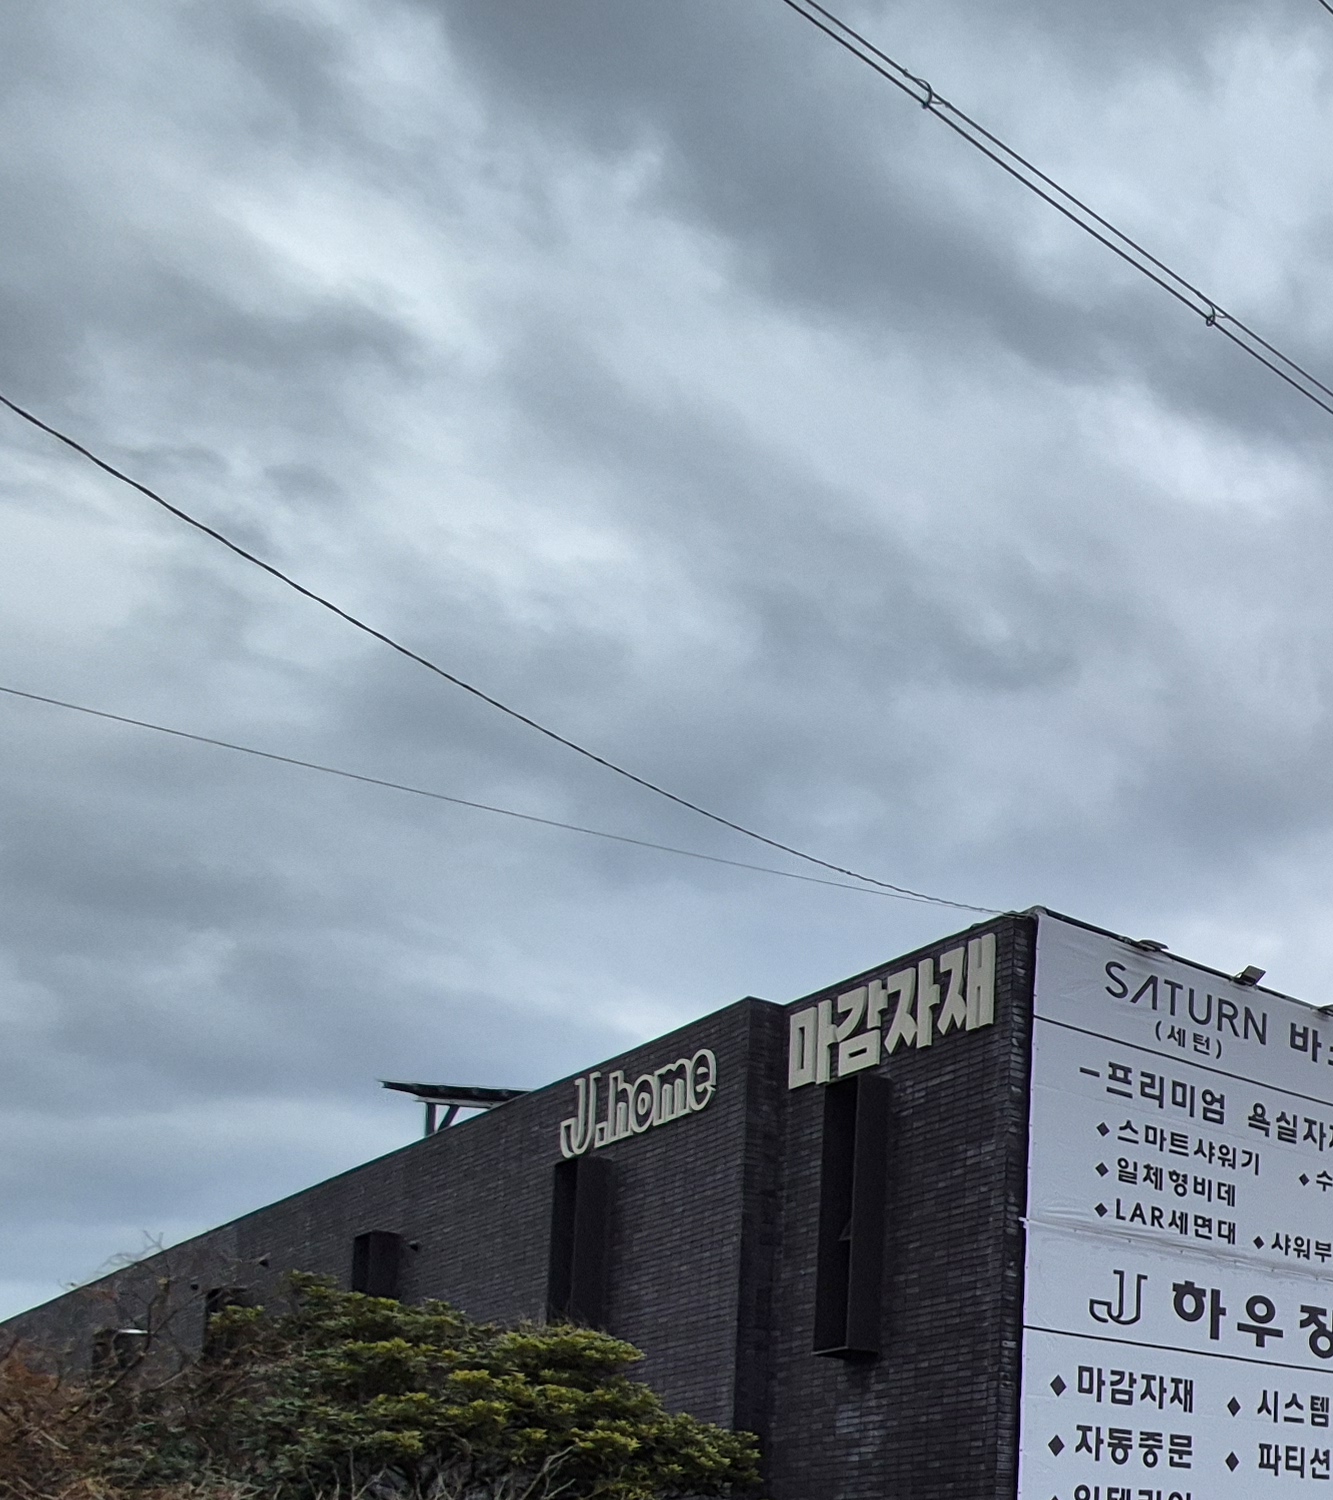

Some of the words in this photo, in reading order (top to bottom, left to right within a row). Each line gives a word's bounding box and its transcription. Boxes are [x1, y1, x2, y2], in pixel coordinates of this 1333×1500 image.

[788, 932, 997, 1090] 마감자재
[1104, 961, 1268, 1045] SATURN
[1117, 1118, 1261, 1176] 스마트샤워기
[1116, 1157, 1237, 1207] 일체형비데
[1115, 1197, 1237, 1246] LAR세면대
[1077, 1365, 1195, 1414] 마감자재
[1074, 1424, 1194, 1470] 자동중문
[1258, 1442, 1331, 1480] 파티션
